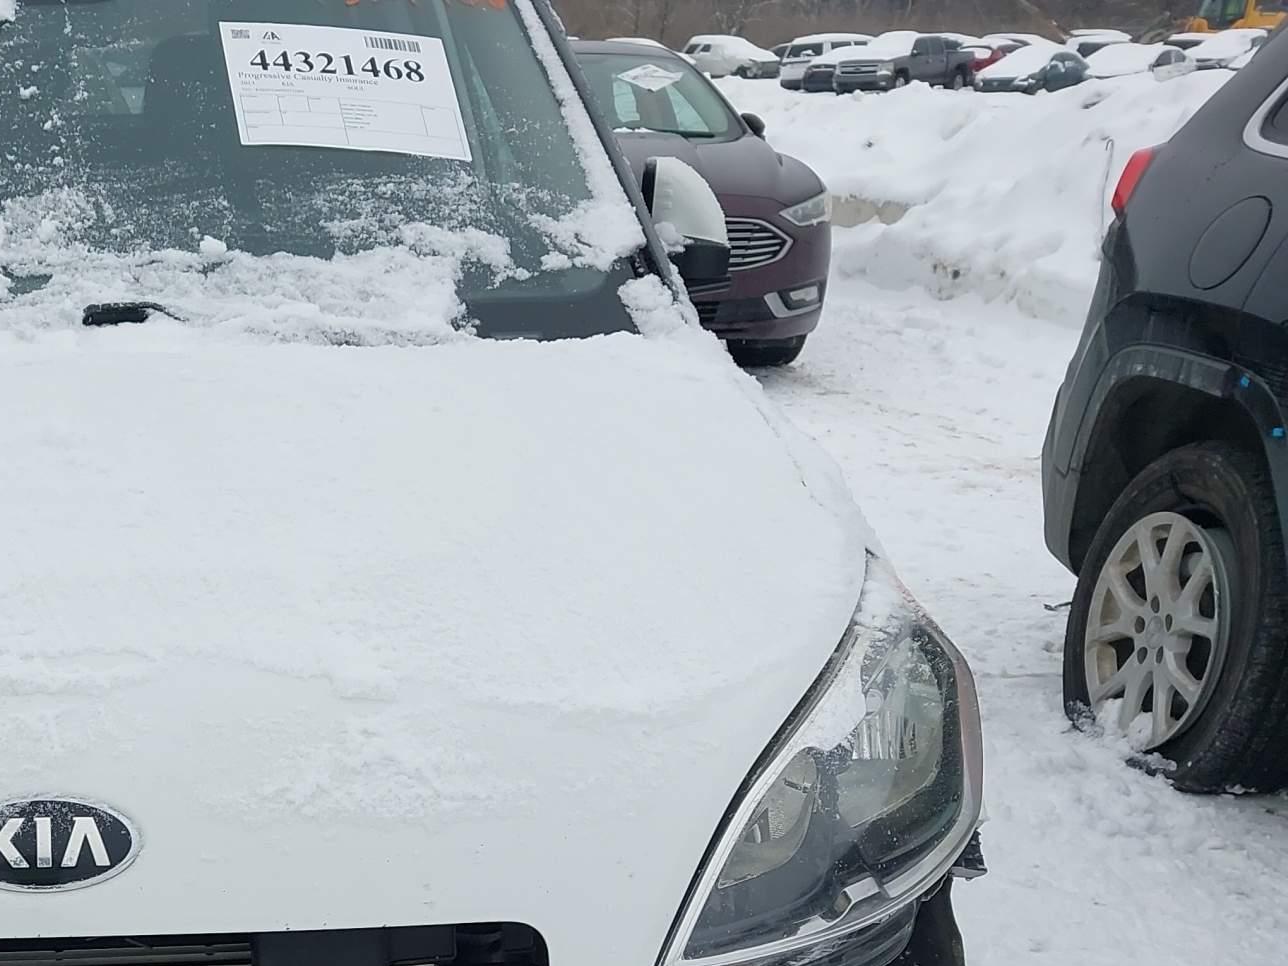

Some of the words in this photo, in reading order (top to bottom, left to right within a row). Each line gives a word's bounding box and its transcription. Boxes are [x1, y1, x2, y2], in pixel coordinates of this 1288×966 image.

[250, 49, 425, 83] 44321468
[238, 72, 291, 80] Progressive
[294, 73, 332, 83] Casualty
[336, 76, 378, 86] Insurance
